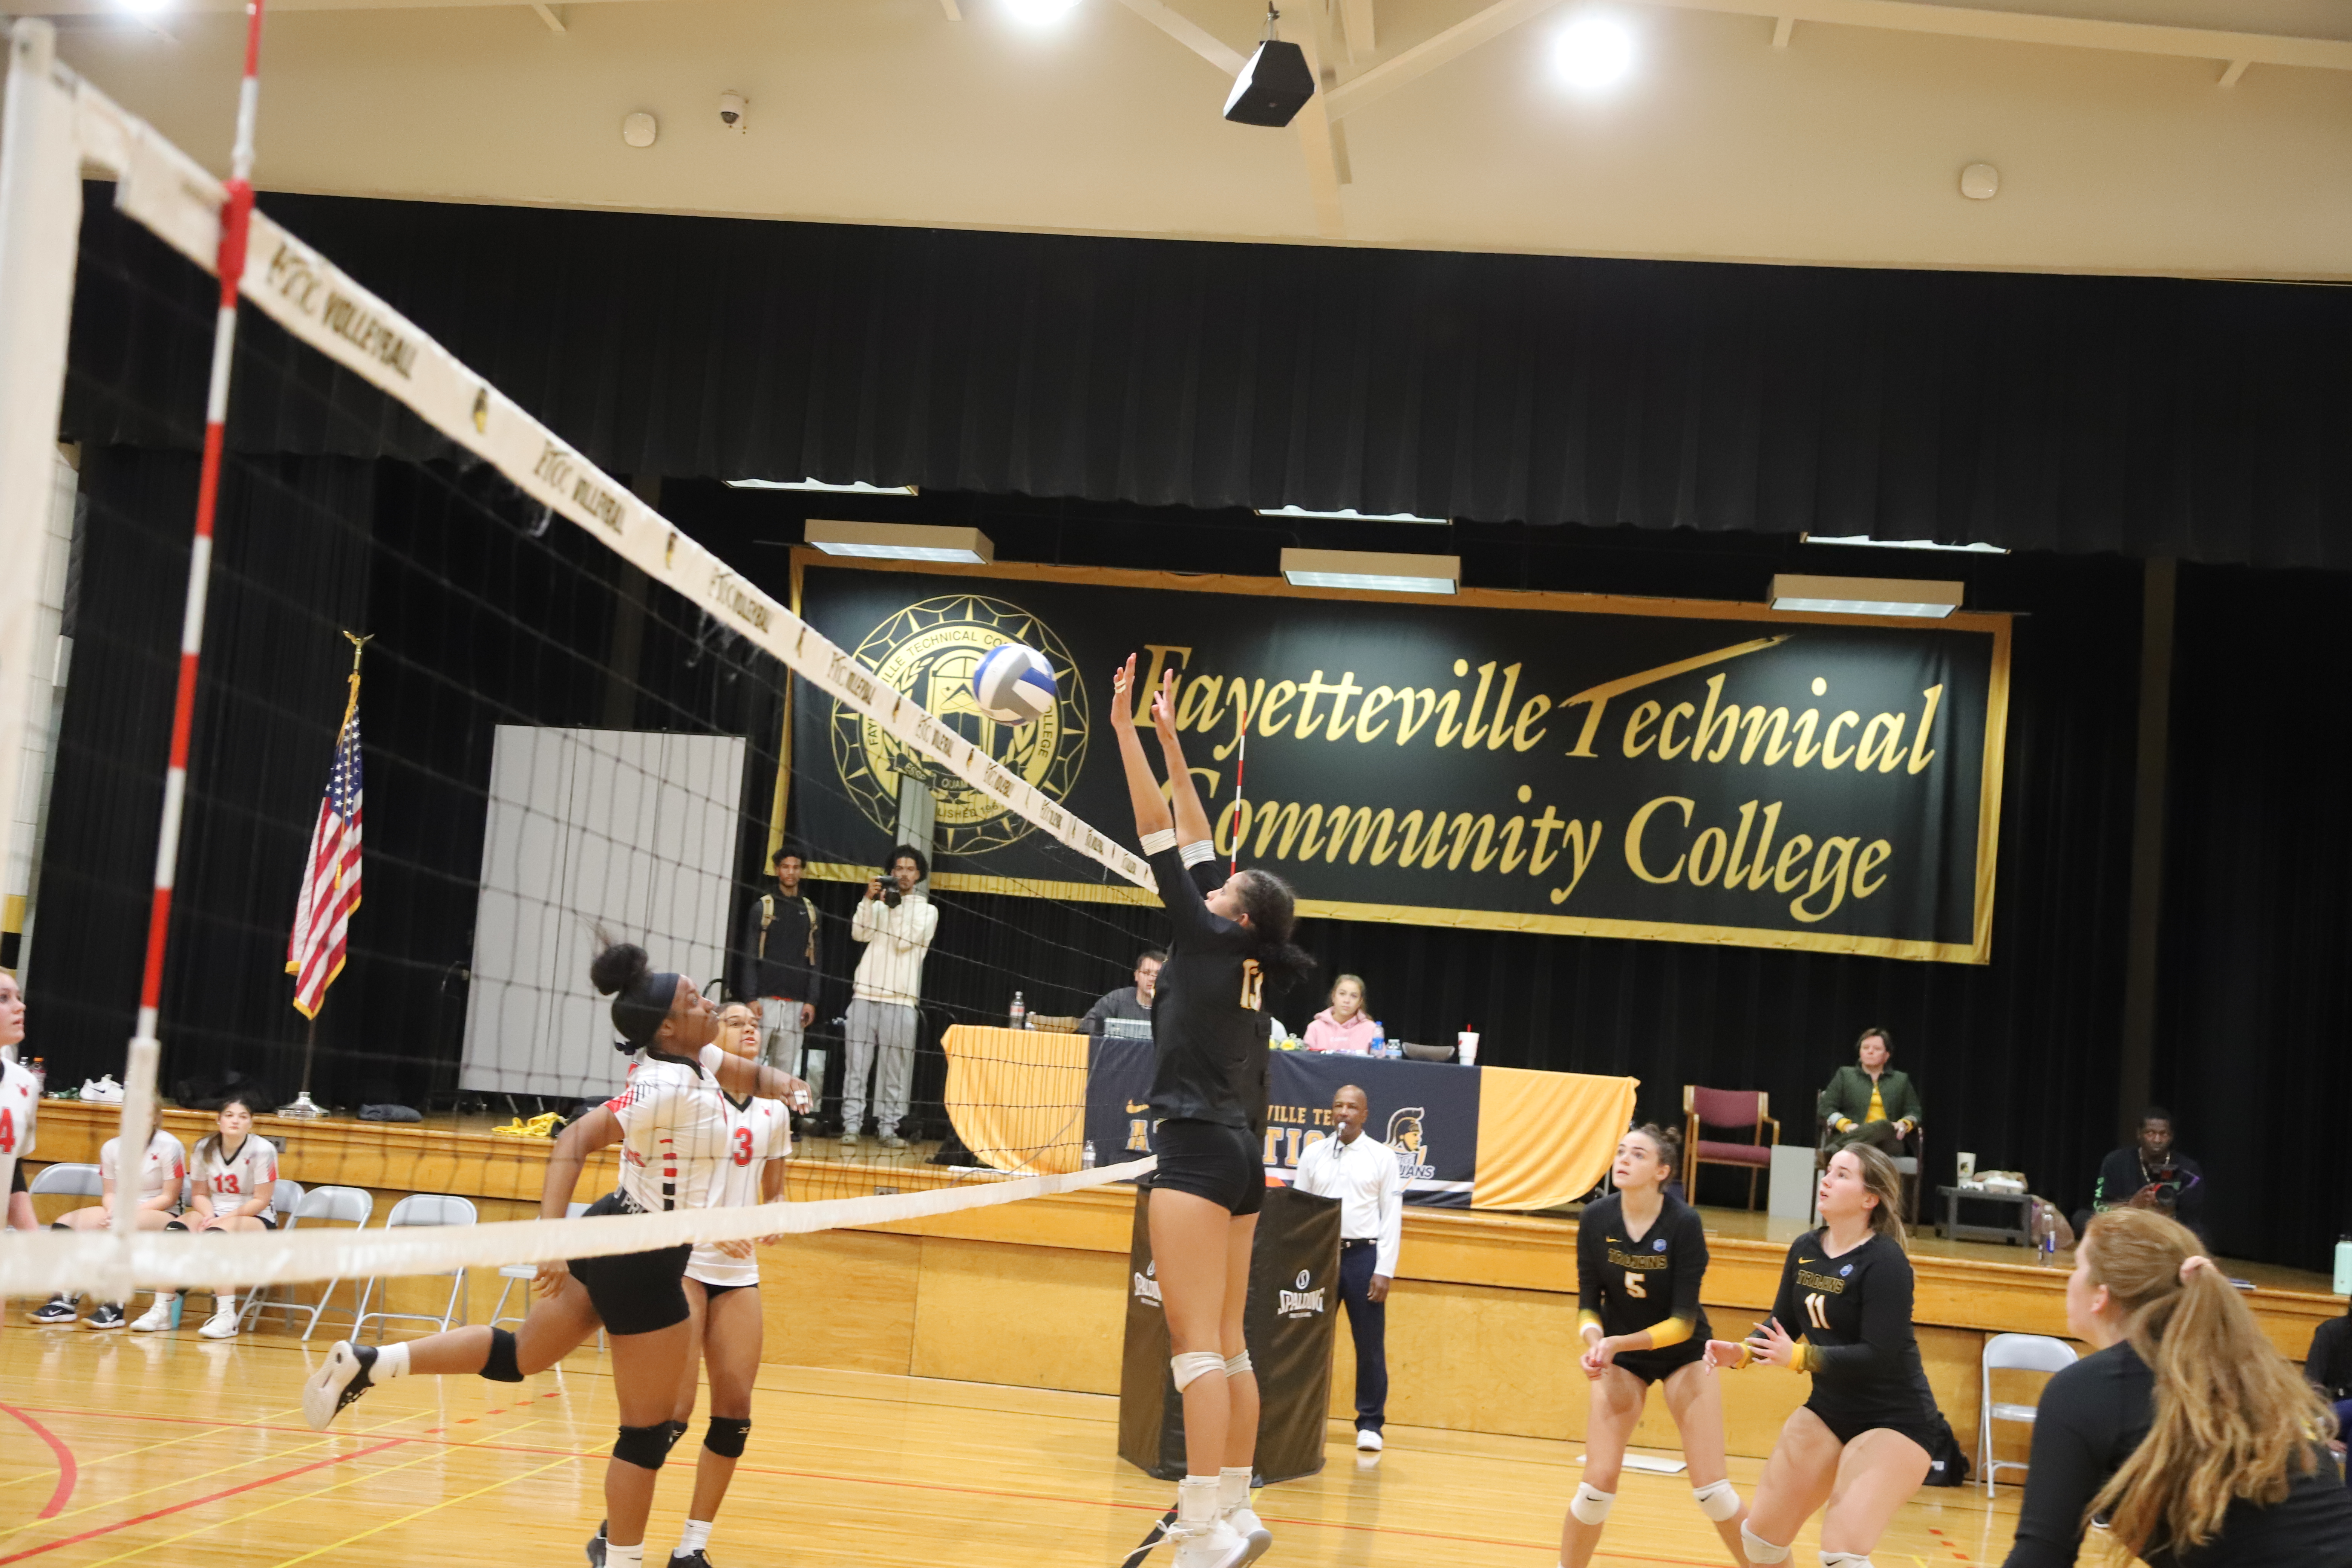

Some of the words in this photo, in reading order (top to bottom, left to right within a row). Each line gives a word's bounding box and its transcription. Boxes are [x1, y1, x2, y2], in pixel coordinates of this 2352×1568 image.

[906, 631, 978, 657] TECHNICAL
[1132, 644, 1551, 761] Fayetteville
[1557, 633, 1943, 775] Technical
[1038, 704, 1054, 758] OLLEGE
[1160, 767, 1603, 905] Community
[1624, 795, 1892, 922] College
[733, 1127, 753, 1167] 3
[214, 1174, 240, 1194] 13
[1608, 1248, 1668, 1269] TROJANS
[1134, 1272, 1162, 1302] SPALDIN
[1625, 1271, 1647, 1298] 5
[1796, 1269, 1845, 1294] TROJANS
[1277, 1287, 1326, 1315] SPALDING
[1804, 1292, 1831, 1329] 11
